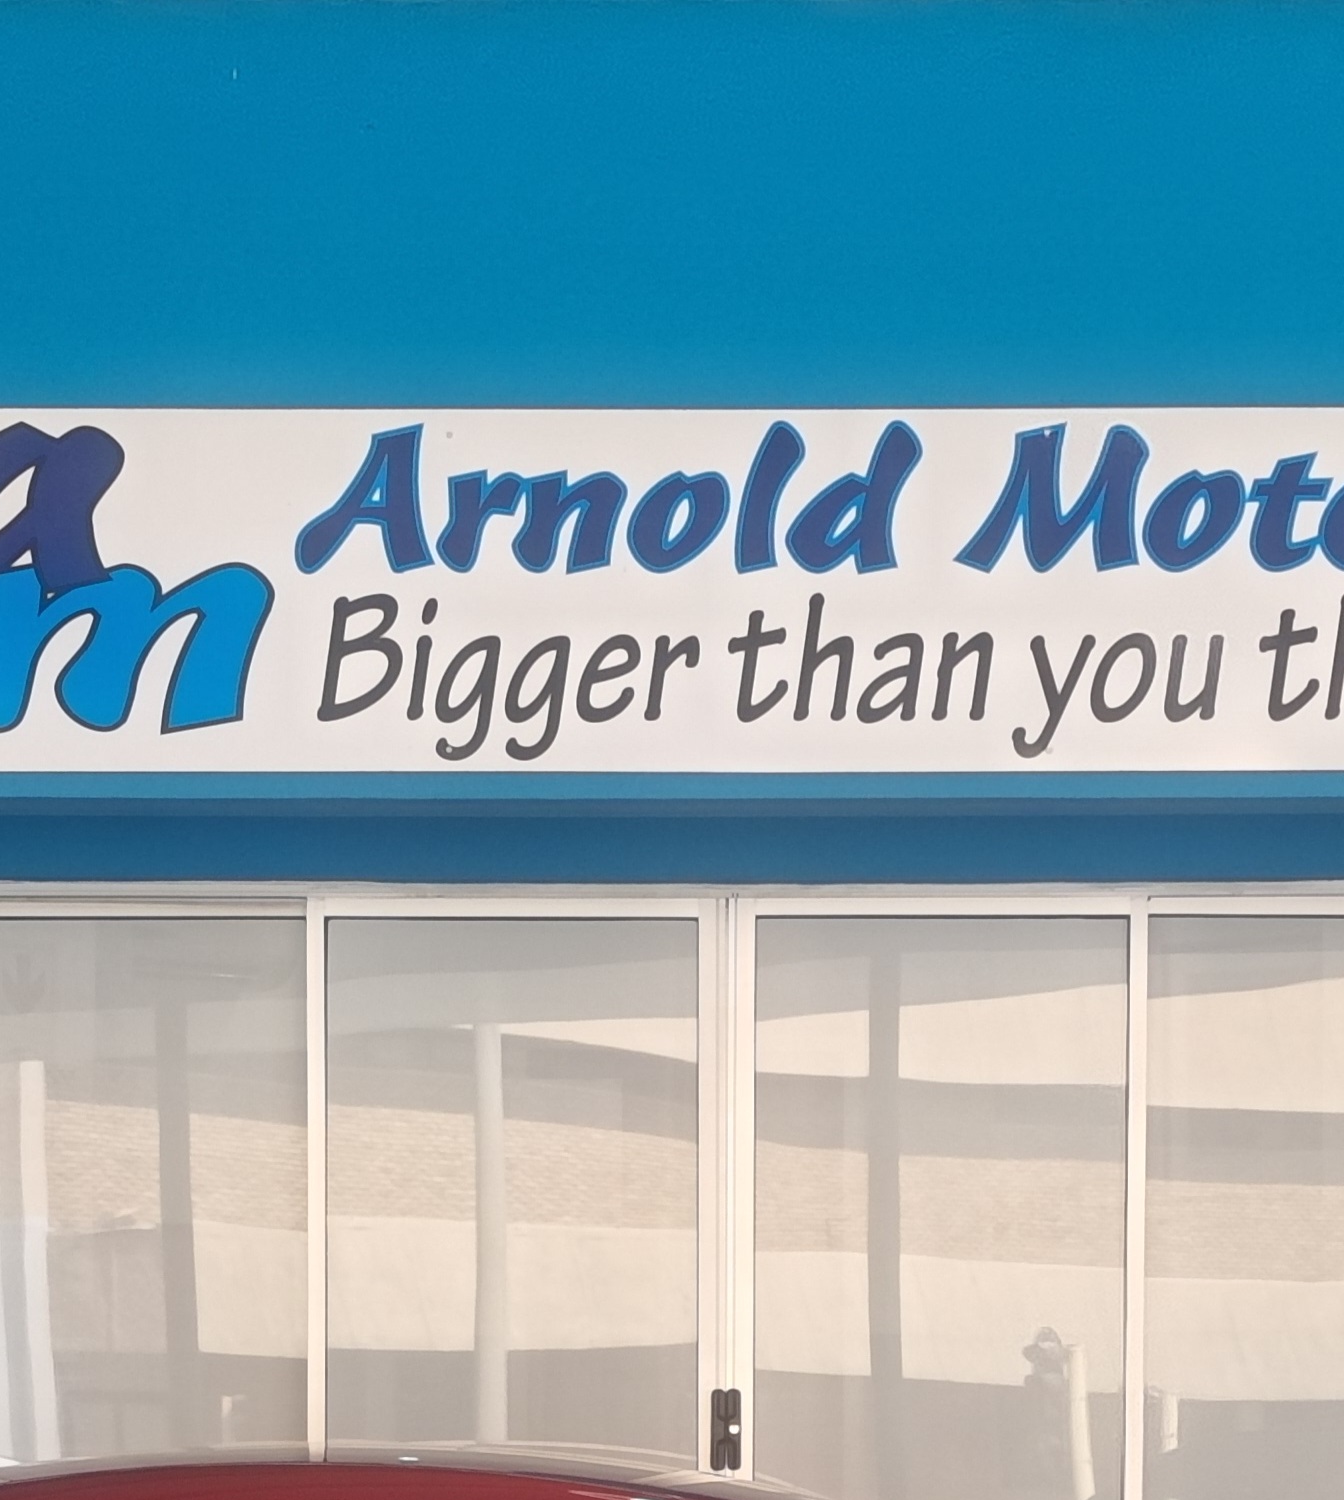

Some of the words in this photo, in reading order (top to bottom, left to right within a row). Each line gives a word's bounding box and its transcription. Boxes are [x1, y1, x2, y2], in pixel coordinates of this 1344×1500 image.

[293, 420, 923, 575] Arnold
[316, 591, 701, 762] Bigger
[726, 590, 996, 725] than
[1009, 633, 1226, 759] you
